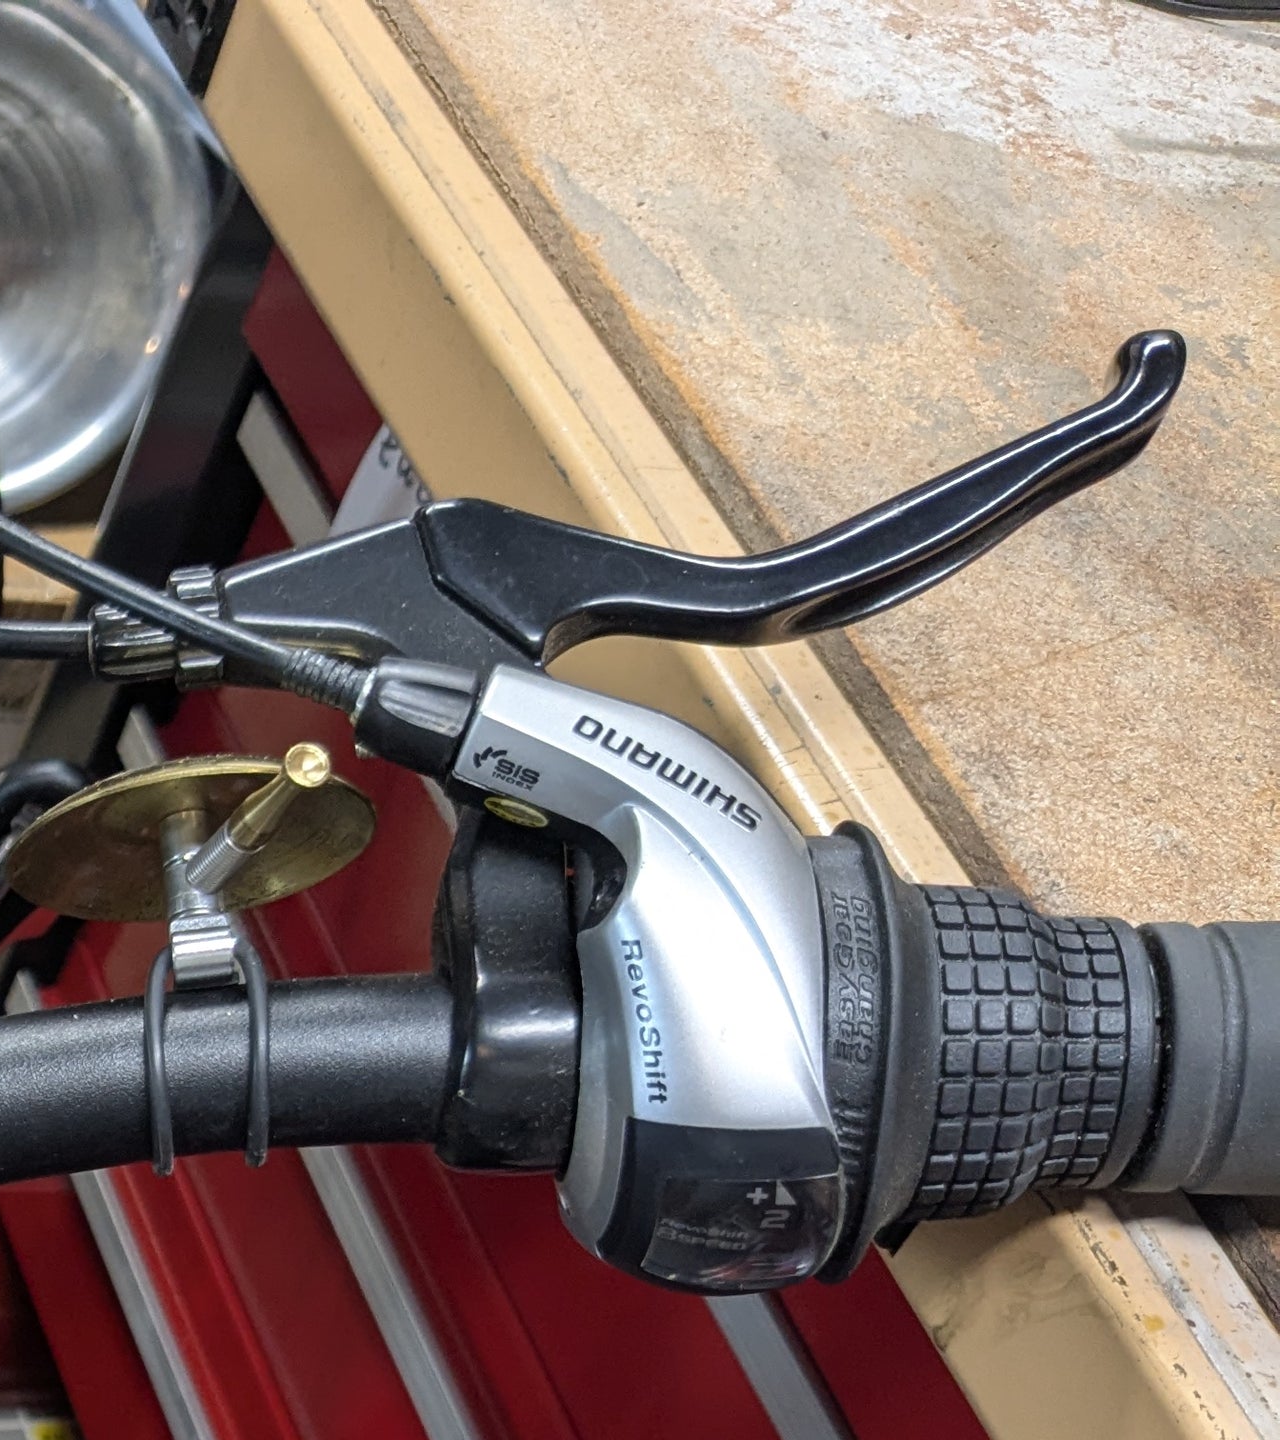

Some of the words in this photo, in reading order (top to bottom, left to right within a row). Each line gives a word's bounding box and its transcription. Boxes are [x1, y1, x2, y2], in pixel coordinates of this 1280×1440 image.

[491, 770, 534, 792] INDEX
[494, 758, 541, 785] SIS
[571, 713, 763, 833] SHIMANO
[620, 939, 668, 1104] RevoShift
[759, 1209, 790, 1229] 2
